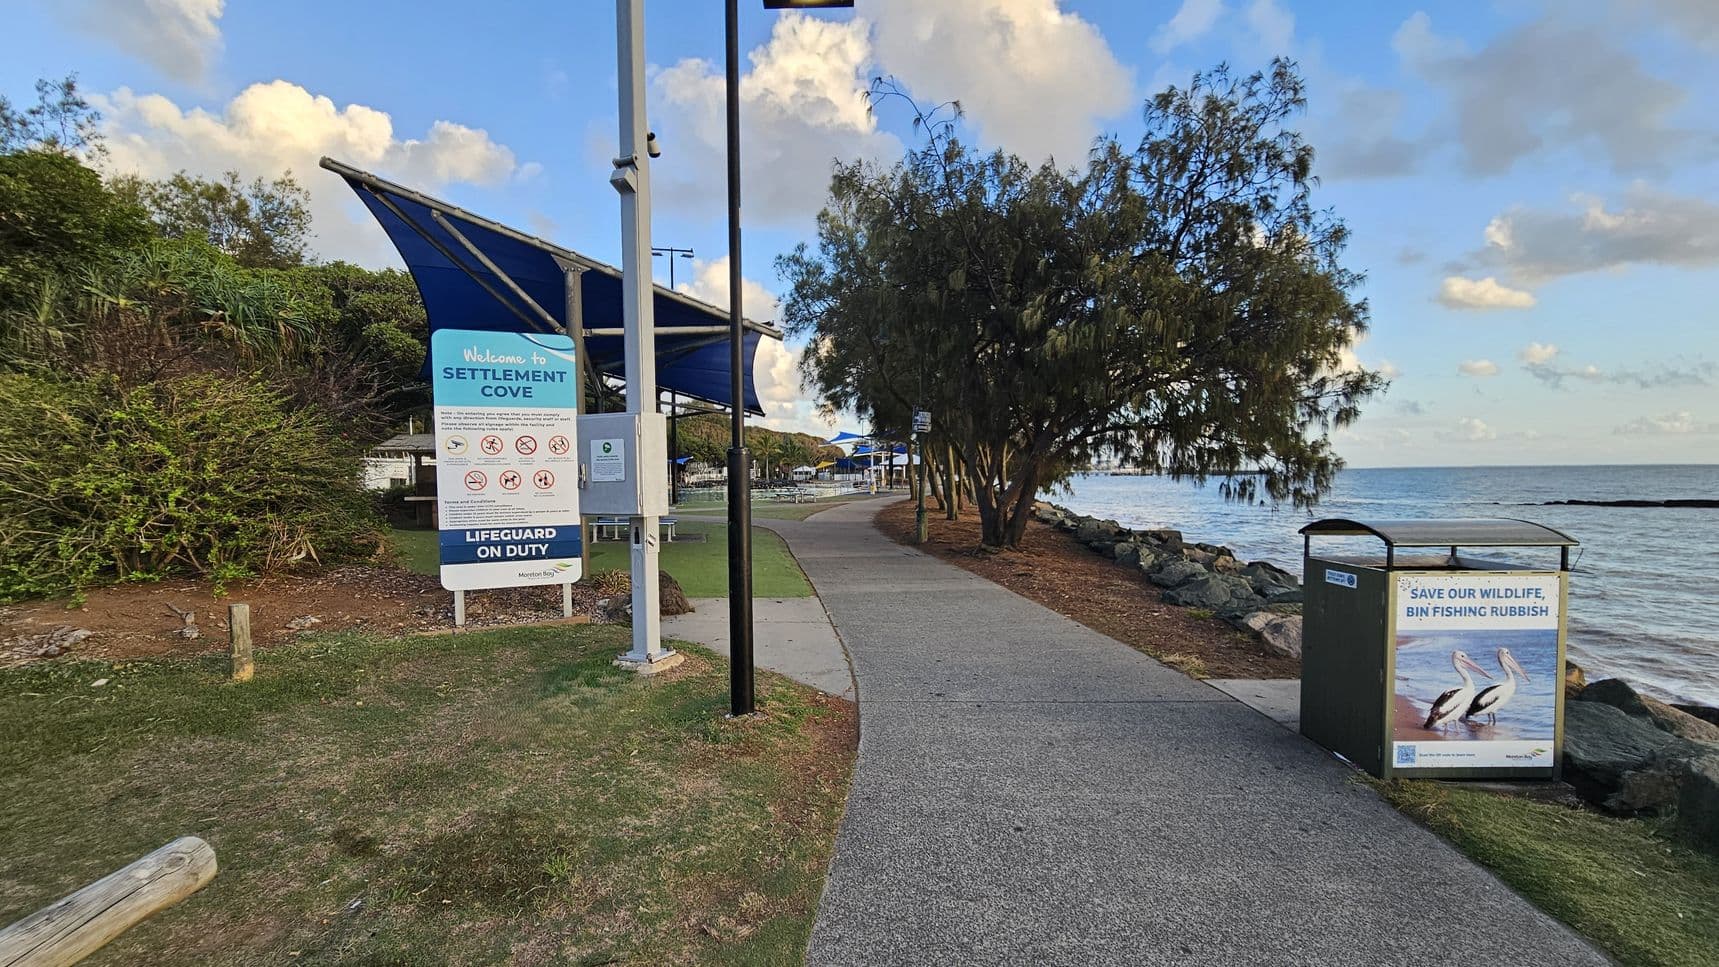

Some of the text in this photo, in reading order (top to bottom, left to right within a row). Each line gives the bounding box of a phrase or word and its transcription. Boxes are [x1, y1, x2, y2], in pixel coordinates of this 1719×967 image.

[463, 345, 547, 365] Welcome to
[443, 367, 567, 382] SETTLEMENT
[481, 385, 533, 398] COVE
[466, 528, 556, 542] LIFEGUARD
[477, 544, 549, 558] ON DUTY
[1410, 588, 1546, 600] SAVE OUR WILDLIFE,
[1406, 606, 1549, 617] BIN FISHING RUBBISH
